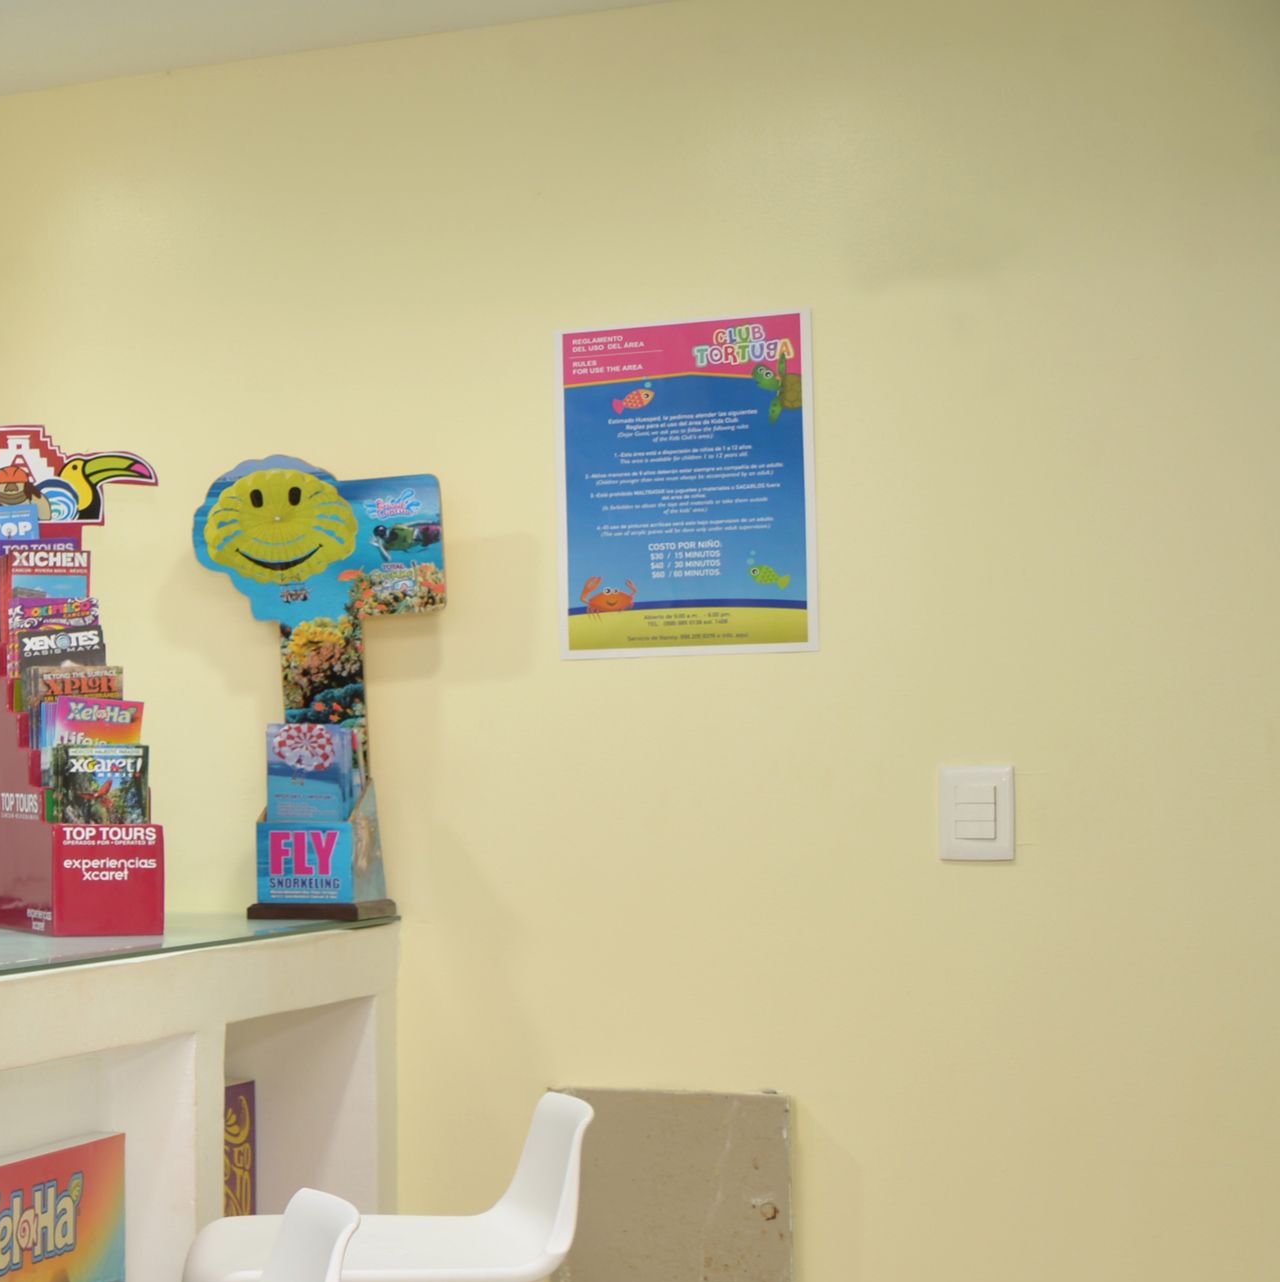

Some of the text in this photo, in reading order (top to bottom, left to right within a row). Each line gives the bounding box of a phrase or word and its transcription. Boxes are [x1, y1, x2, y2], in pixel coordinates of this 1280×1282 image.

[572, 335, 624, 345] REGLAMENTO
[712, 323, 766, 345] CLUB
[588, 344, 605, 352] USO
[692, 337, 795, 368] TORTUGA
[572, 360, 597, 368] RULES
[572, 363, 644, 375] FOR USE THE AREA
[12, 551, 88, 567] XICHEN
[22, 631, 100, 651] XENOTES
[24, 644, 101, 657] OASIS MAYA
[43, 675, 117, 695] XPLOR
[0, 792, 39, 814] TOP TOURS
[62, 827, 157, 841] TOP TOURS
[269, 830, 340, 877] FLY
[63, 857, 157, 872] experiencias
[82, 866, 129, 881] xcaret
[269, 878, 340, 889] SNORKELING
